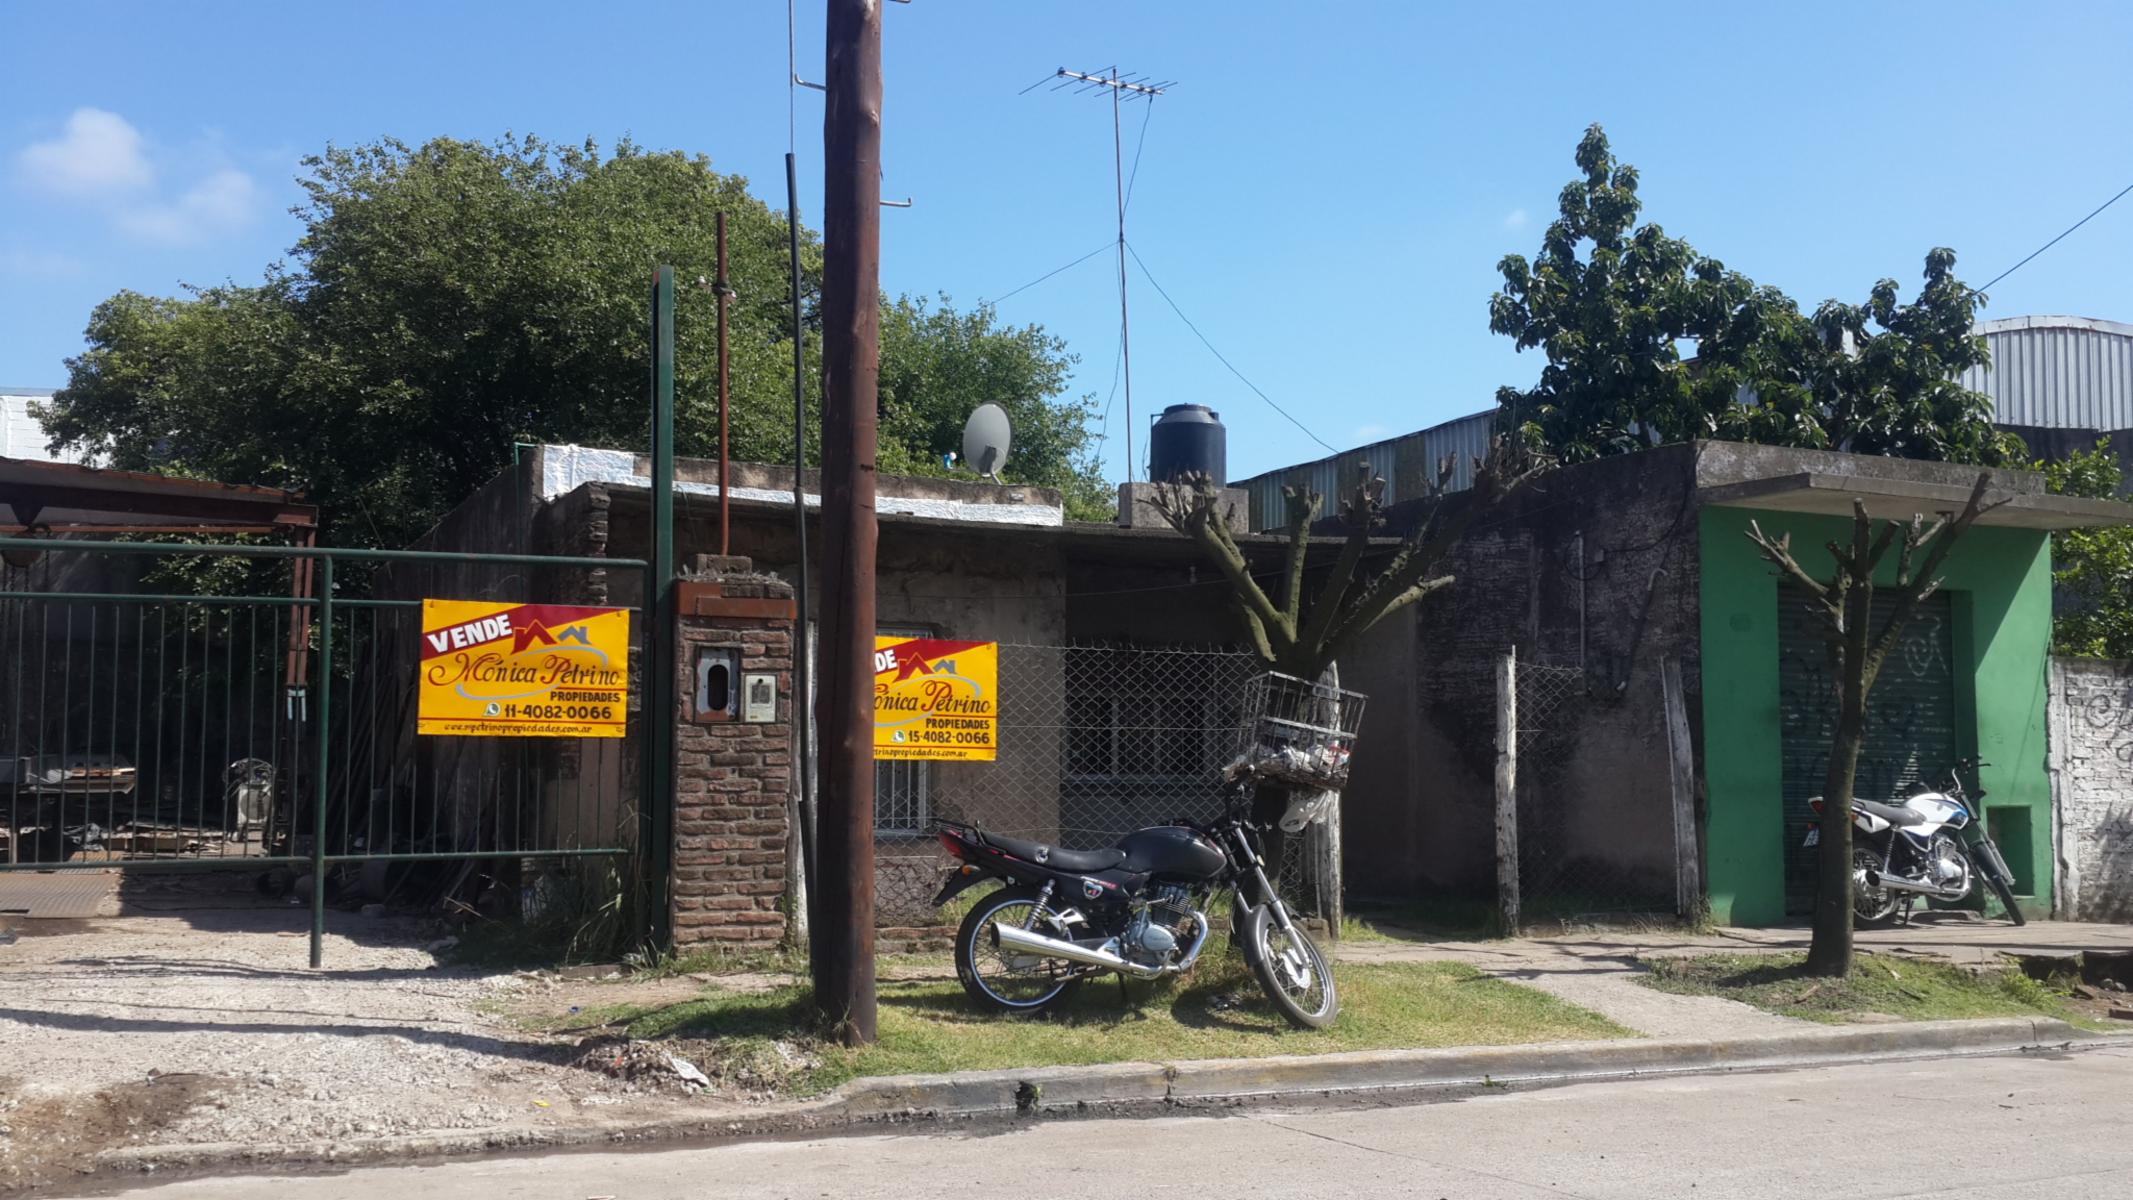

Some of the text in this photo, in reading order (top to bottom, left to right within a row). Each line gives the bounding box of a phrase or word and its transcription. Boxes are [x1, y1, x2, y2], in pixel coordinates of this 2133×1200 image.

[427, 614, 513, 653] VENDE
[428, 652, 621, 686] Mónica Petrino
[550, 691, 621, 703] PROPIEDADES
[921, 679, 991, 713] Petrino
[504, 704, 612, 720] 11-4082-0066
[926, 718, 990, 729] PROPIEDADES
[908, 730, 990, 744] 15-4082-0066
